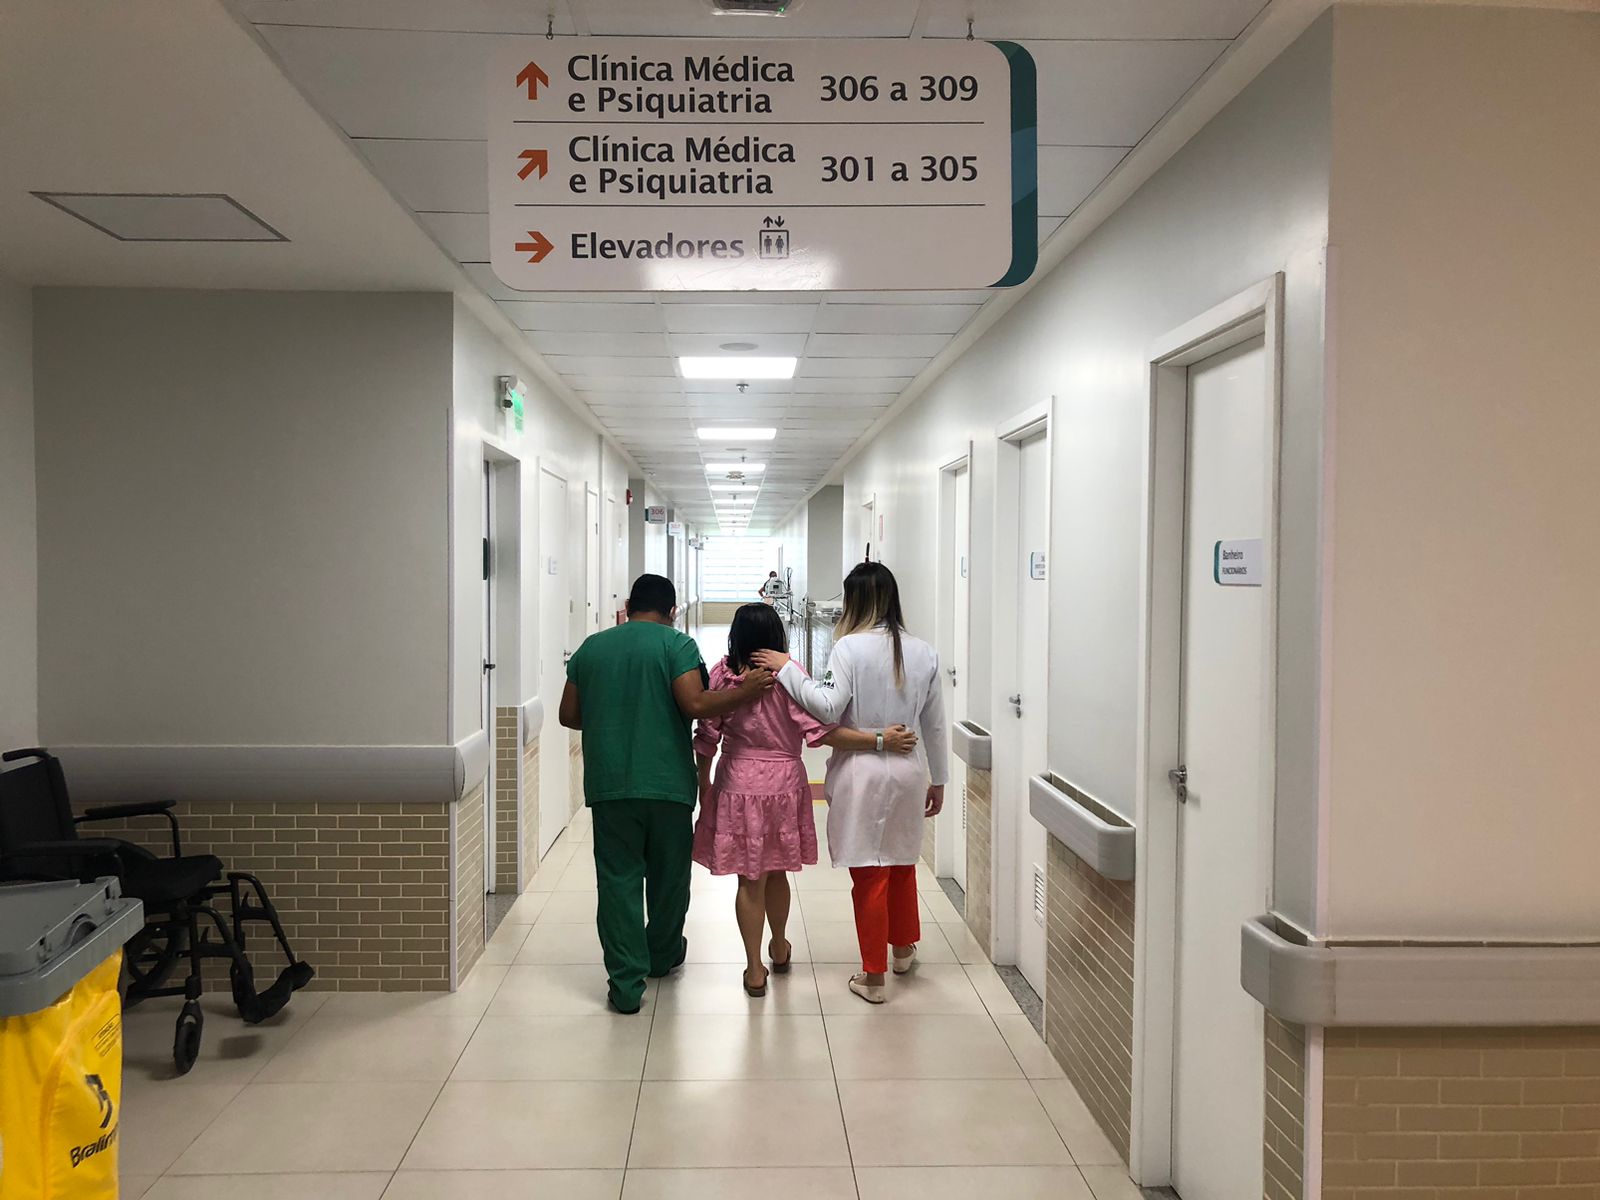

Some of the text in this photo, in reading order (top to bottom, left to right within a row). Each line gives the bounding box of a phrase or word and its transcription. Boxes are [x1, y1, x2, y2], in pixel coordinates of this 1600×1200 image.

[568, 54, 795, 82] Clínica Médica
[568, 87, 773, 118] e Psiquiatria
[820, 75, 979, 102] 306 a 309
[568, 135, 796, 163] Clínica Médica
[821, 156, 978, 182] 301 a 305
[569, 168, 774, 199] e Psiquiatria
[571, 232, 744, 259] Elevadores
